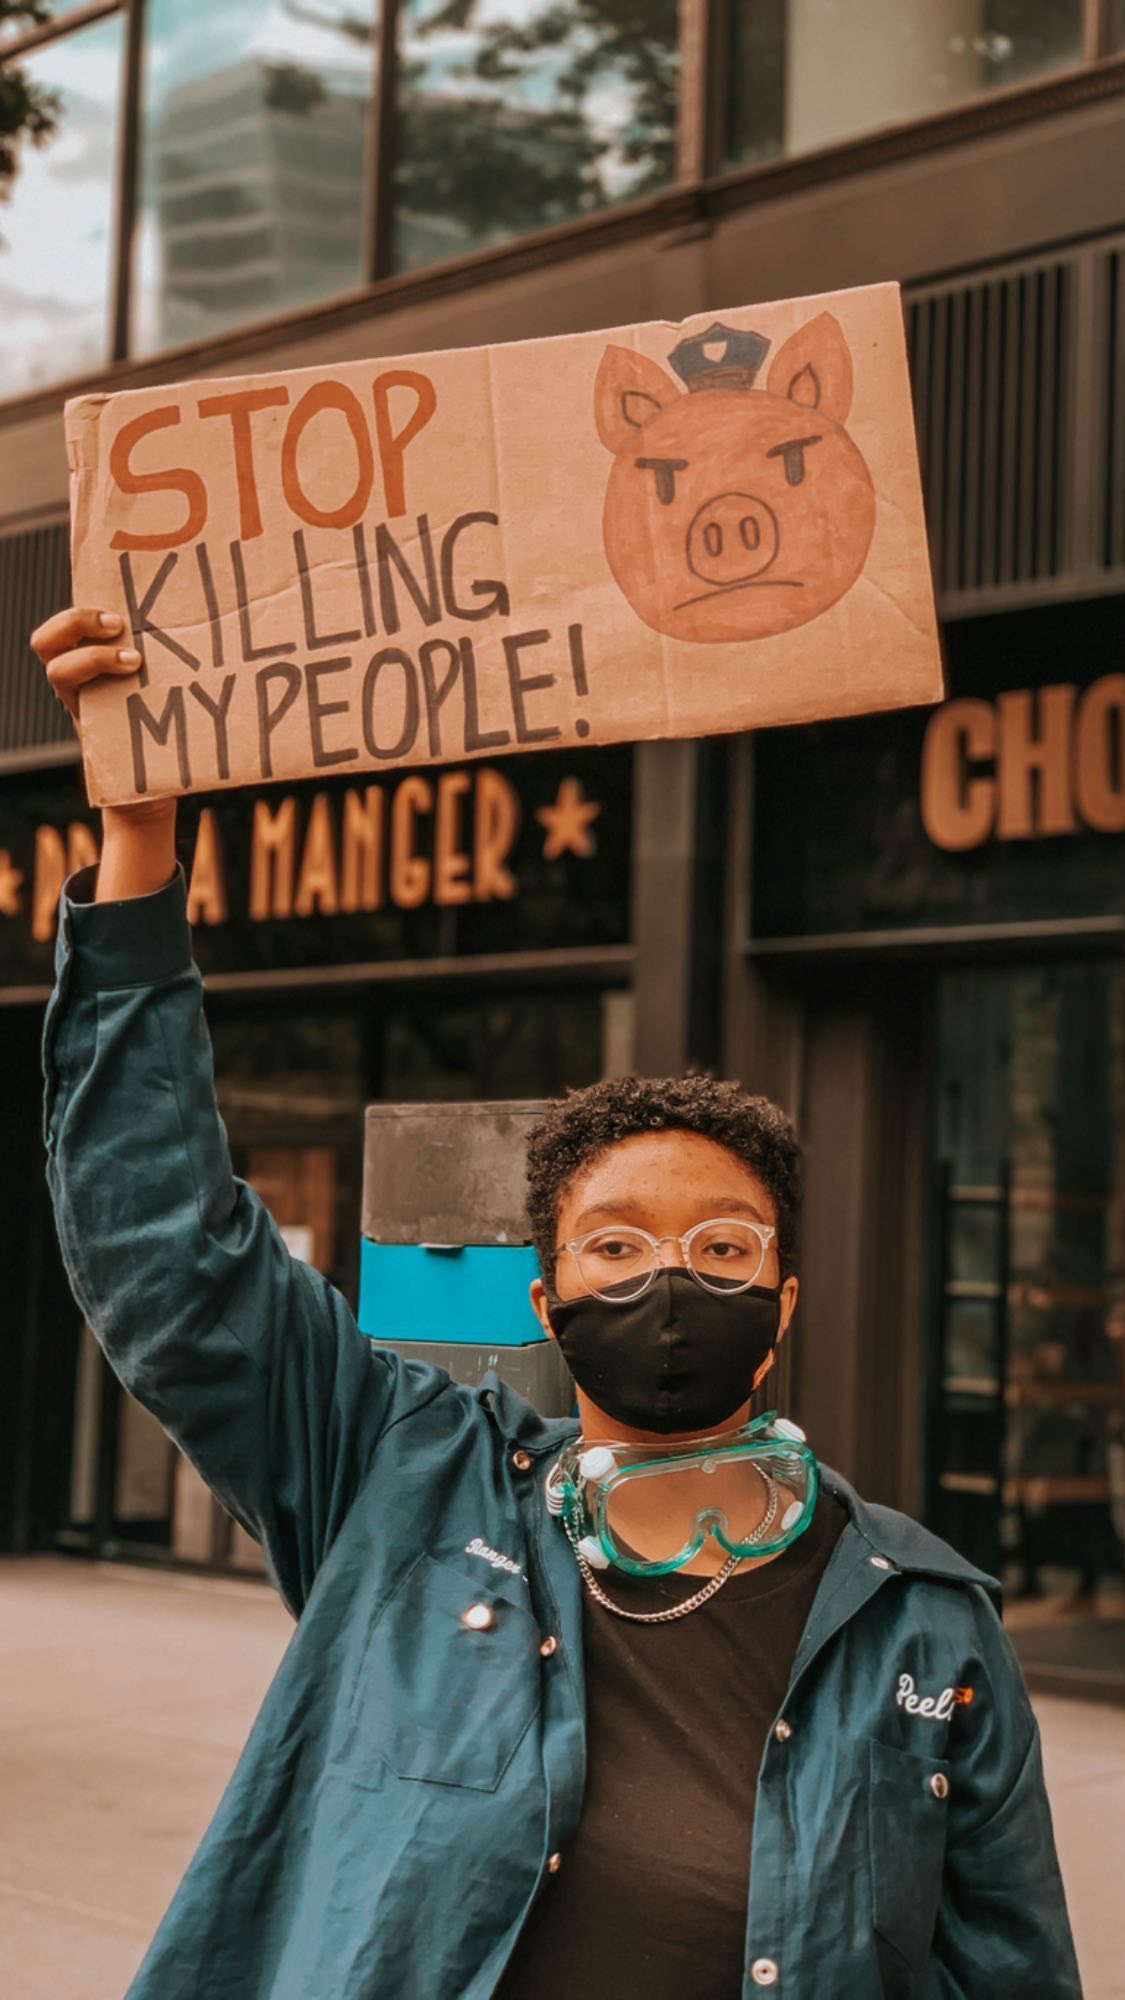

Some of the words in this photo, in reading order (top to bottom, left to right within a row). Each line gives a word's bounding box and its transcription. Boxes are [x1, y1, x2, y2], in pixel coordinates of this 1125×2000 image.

[109, 370, 436, 551] STOP
[119, 512, 511, 687] KILLING
[249, 768, 519, 922] MANGER
[921, 672, 1125, 852] CHO
